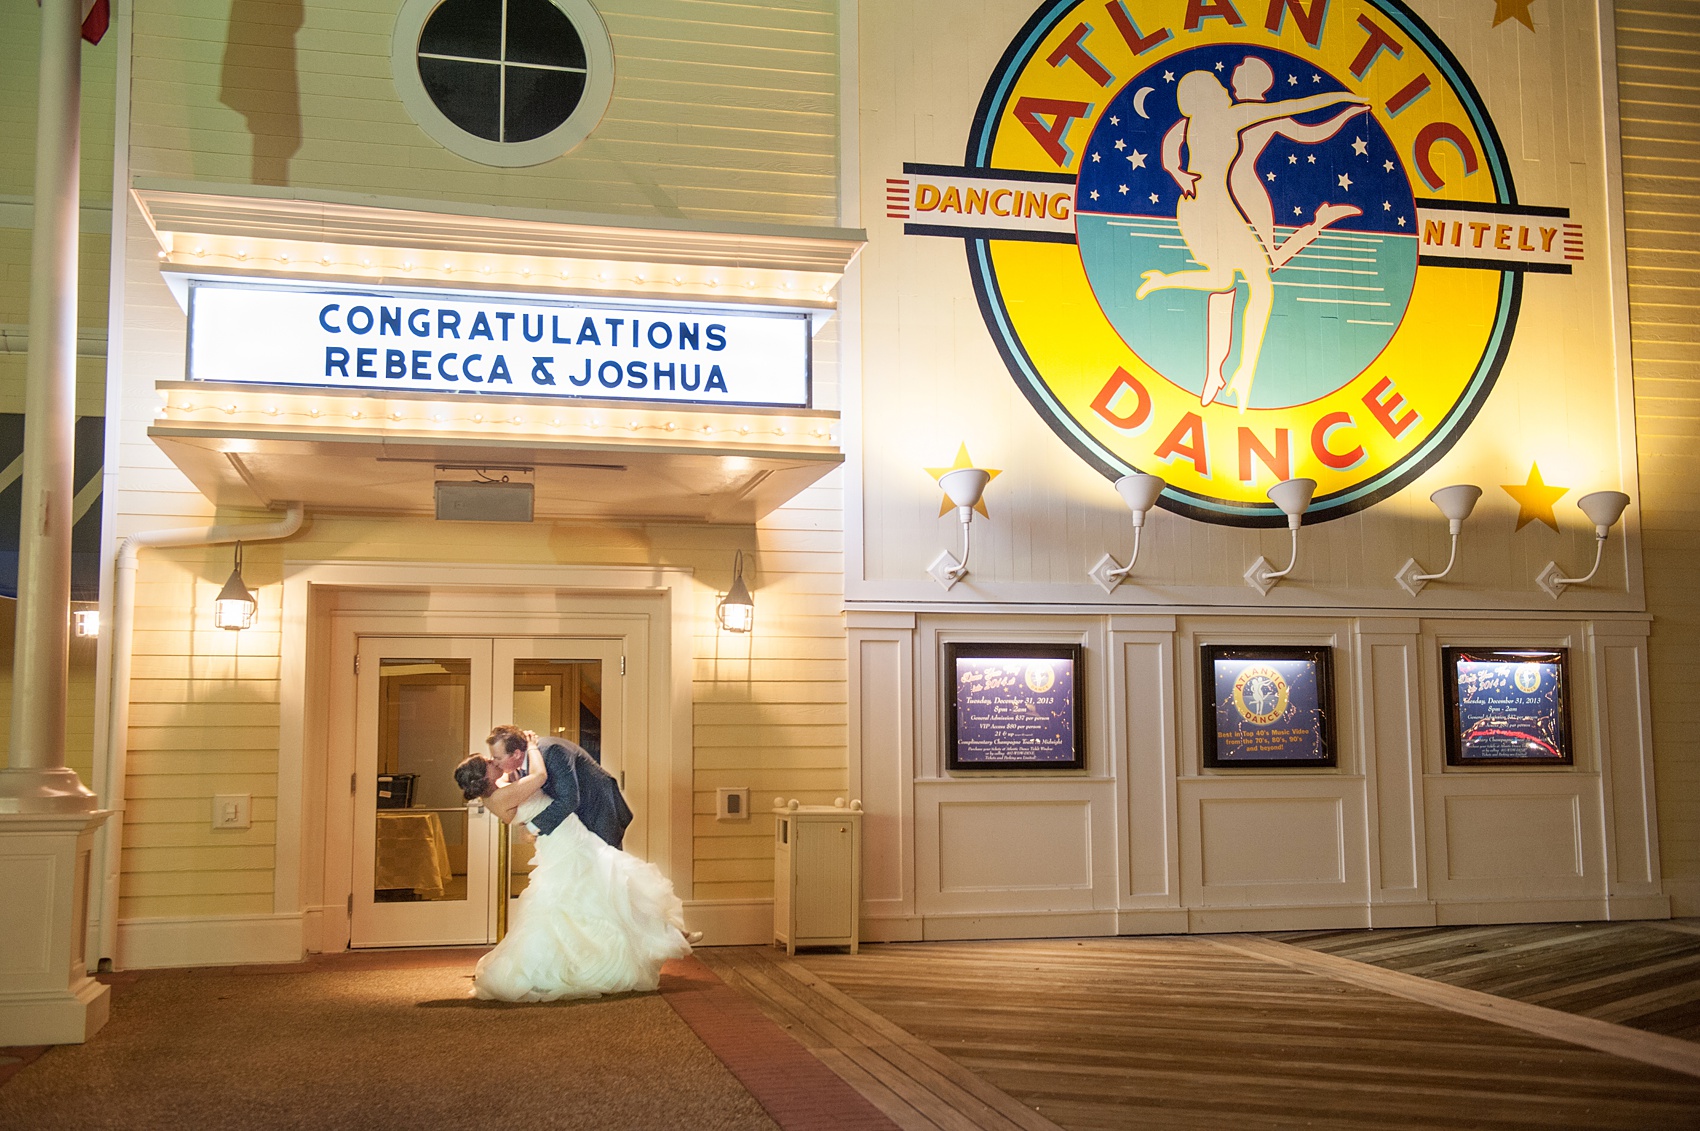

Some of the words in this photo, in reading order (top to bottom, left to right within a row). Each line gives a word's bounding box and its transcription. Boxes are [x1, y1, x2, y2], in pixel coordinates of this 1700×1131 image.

[914, 184, 1071, 220] DANCING
[1423, 219, 1558, 253] NITELY
[319, 303, 728, 352] CONGRATULATIONS
[325, 346, 513, 385] REBECCA
[531, 356, 556, 385] &
[569, 358, 729, 393] JOSHUA
[1090, 365, 1421, 482] DANCE
[1235, 667, 1286, 691] ATLANTIC
[966, 696, 992, 705] Tuesday,
[994, 696, 1023, 705] December
[1025, 696, 1035, 705] 31,
[1036, 696, 1054, 705] 2013
[1488, 697, 1514, 705] December
[1514, 697, 1524, 705] 31,
[1525, 697, 1541, 705] 2013
[1244, 710, 1280, 723] DANCE
[1259, 744, 1284, 752] beyond!
